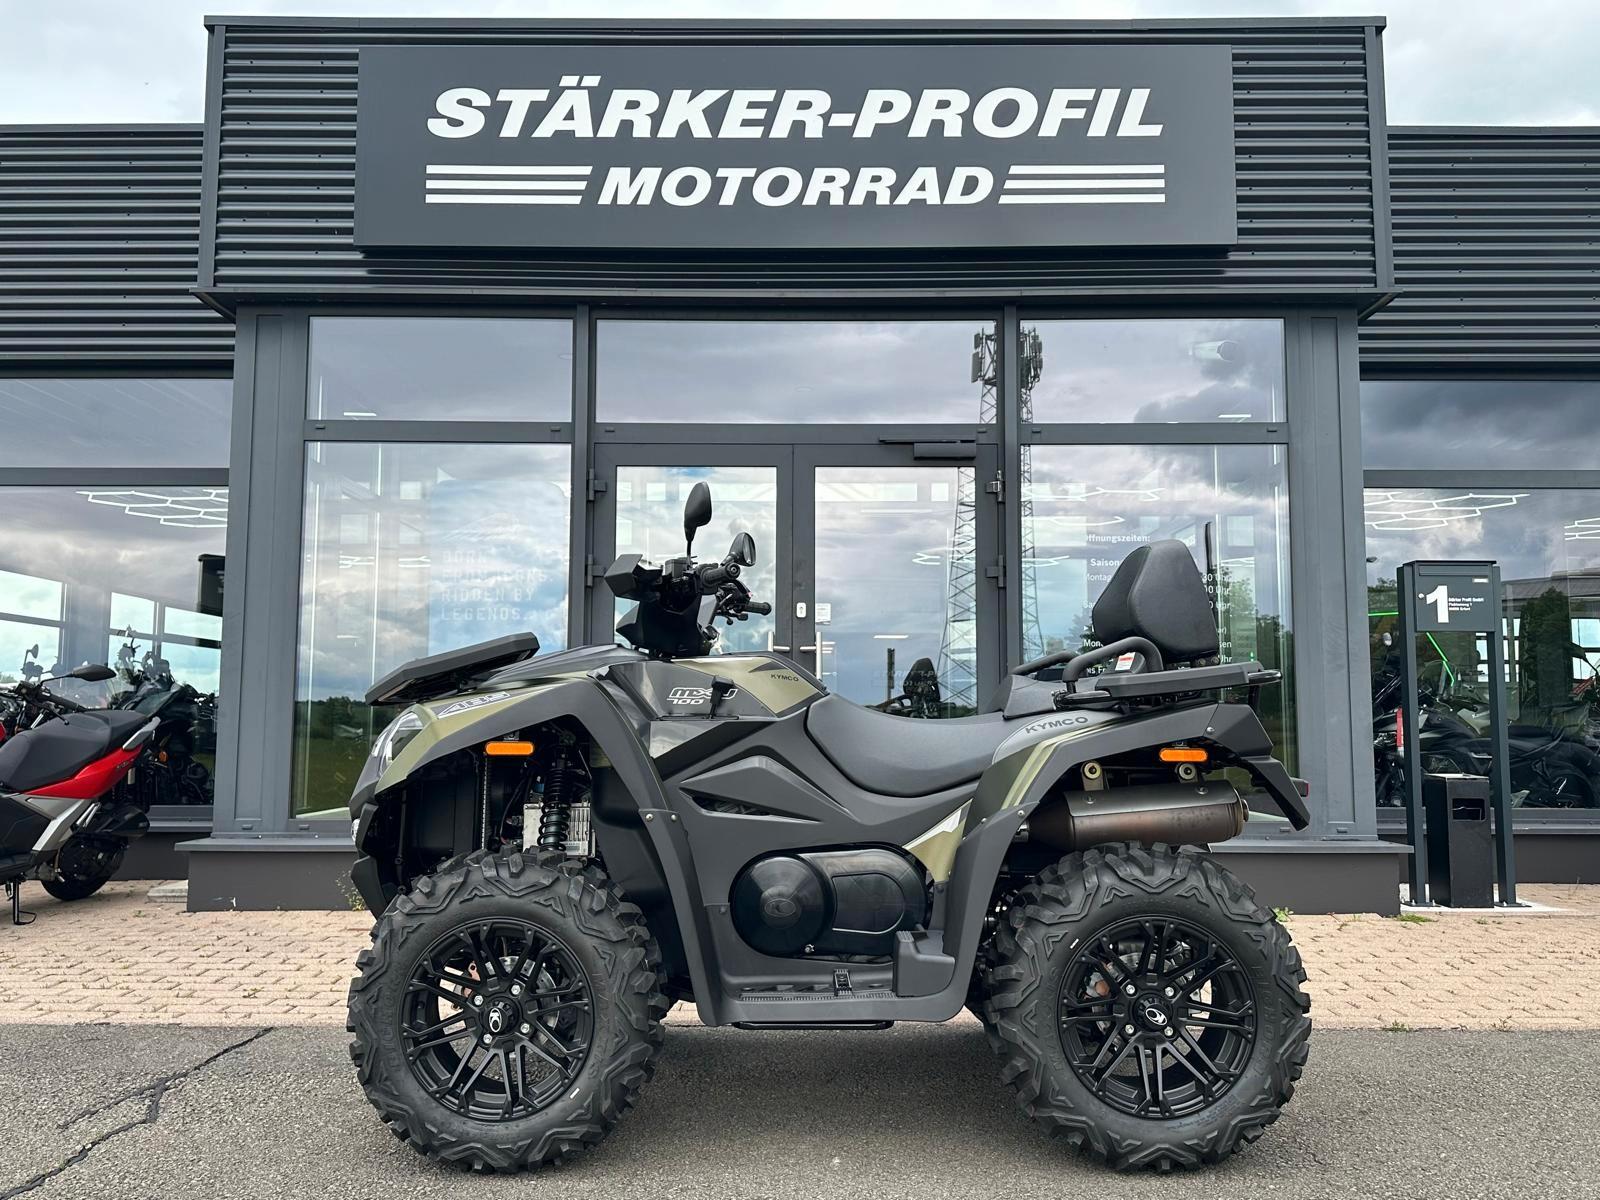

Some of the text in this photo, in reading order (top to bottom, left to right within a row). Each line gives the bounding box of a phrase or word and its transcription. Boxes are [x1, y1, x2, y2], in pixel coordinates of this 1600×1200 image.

[427, 76, 1163, 138] STÄRKER-PROFIL
[598, 167, 993, 206] MOTORRAD
[1085, 533, 1150, 543] ffnungszeiten:
[1426, 586, 1449, 623] 1
[770, 673, 800, 682] KYMCO
[1025, 716, 1089, 734] KYMCO
